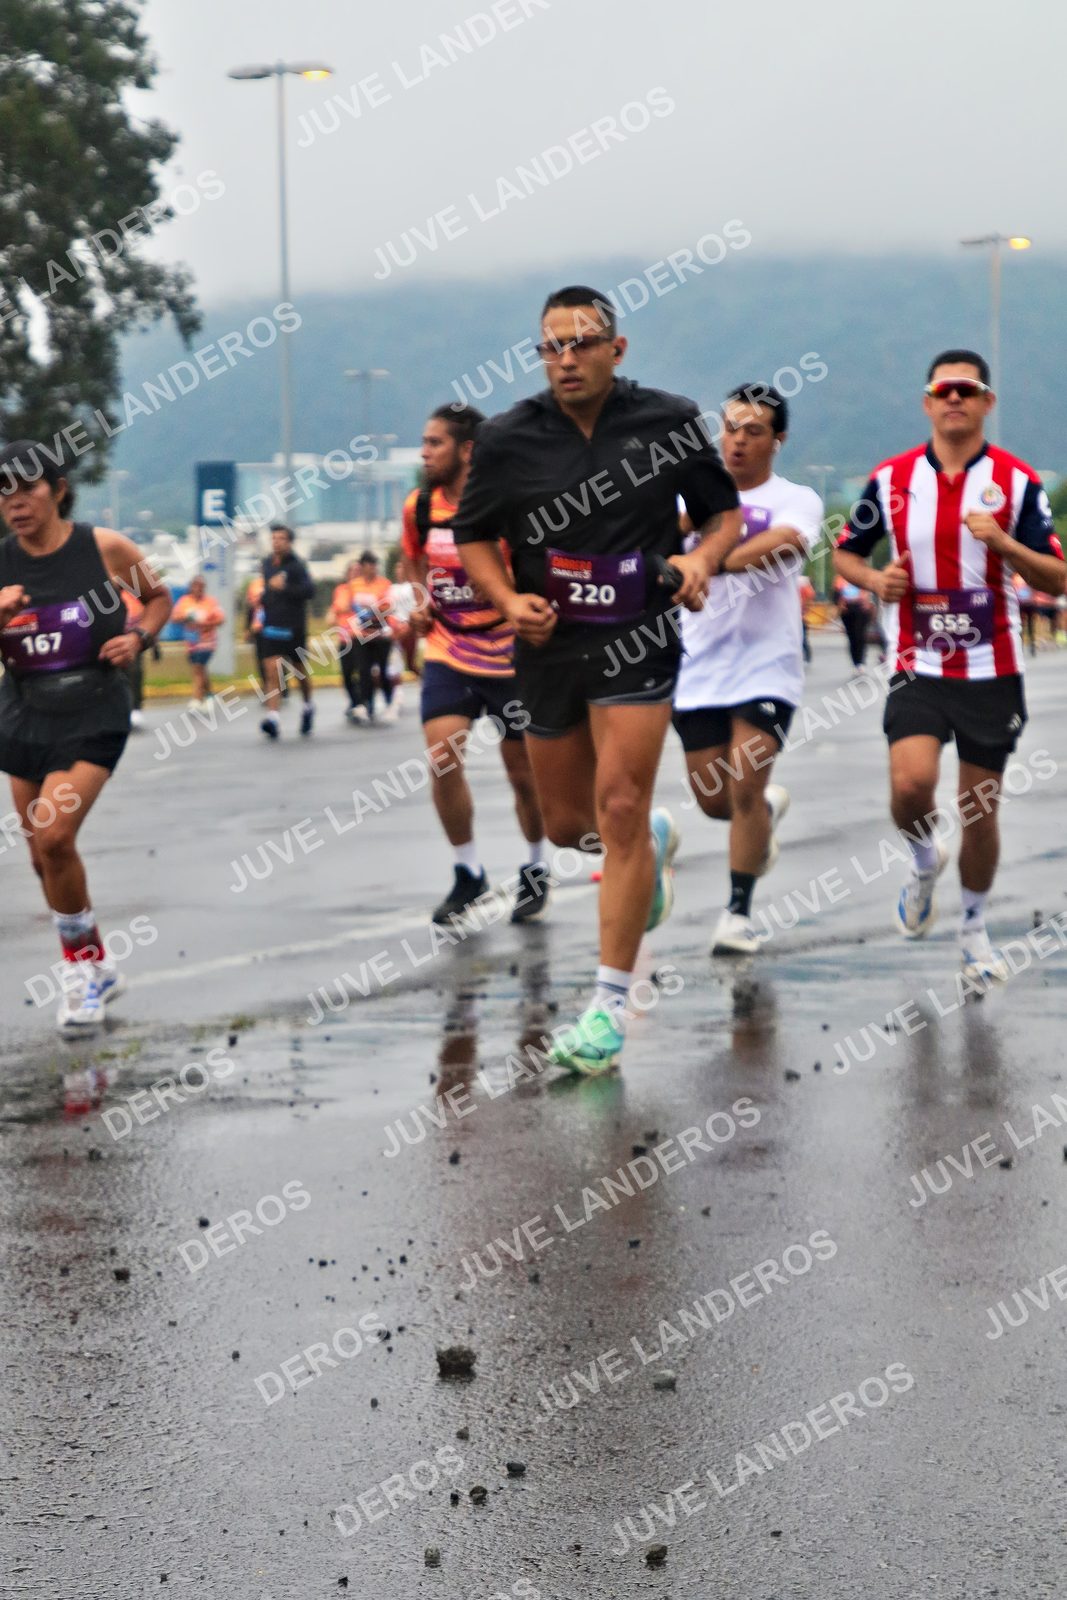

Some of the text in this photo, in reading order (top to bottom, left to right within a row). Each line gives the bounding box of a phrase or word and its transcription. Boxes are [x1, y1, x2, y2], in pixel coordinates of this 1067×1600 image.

[203, 489, 226, 519] E
[568, 582, 616, 606] 220
[930, 613, 971, 633] 655
[21, 631, 62, 656] 167
